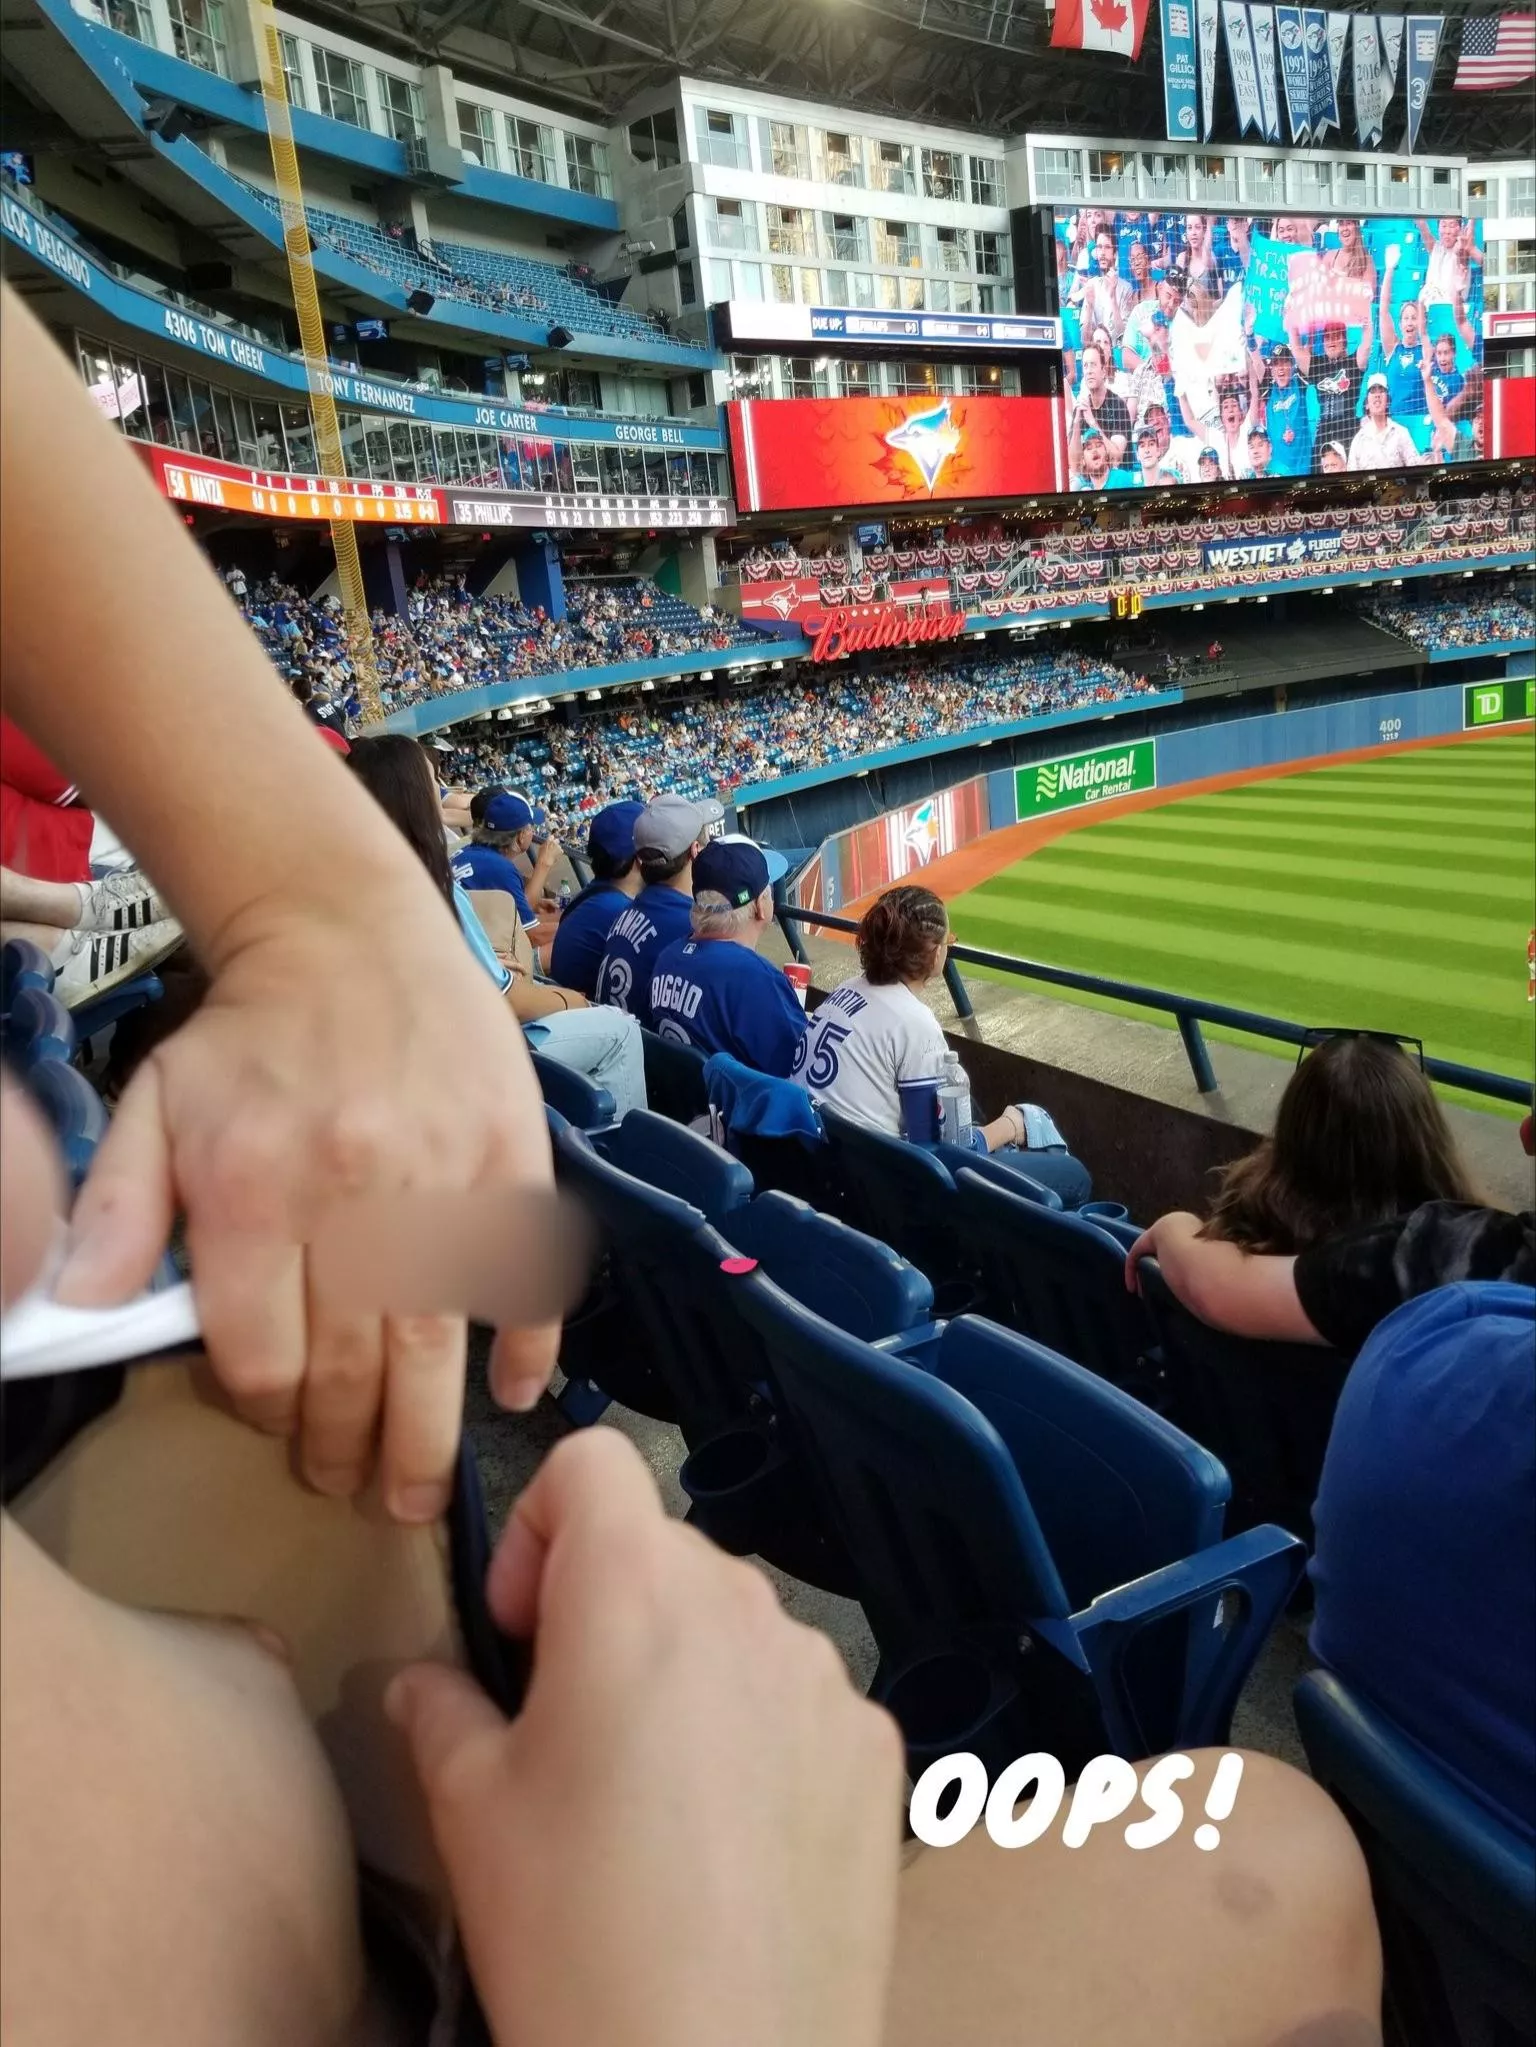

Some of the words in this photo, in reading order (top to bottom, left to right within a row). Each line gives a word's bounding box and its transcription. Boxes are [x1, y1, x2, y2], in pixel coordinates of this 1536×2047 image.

[1176, 53, 1189, 64] PAT
[1260, 53, 1274, 70] 199
[1284, 55, 1306, 73] 1992
[1309, 54, 1329, 79] 1993
[1286, 76, 1307, 87] WORL
[1357, 62, 1380, 81] 2016
[1411, 77, 1427, 110] 3
[34, 222, 90, 289] DELGADO
[812, 316, 829, 331] DUE
[165, 309, 197, 345] 4306
[199, 324, 229, 358] TOM
[231, 338, 266, 374] CHEEK
[317, 372, 349, 398] TONY
[354, 381, 416, 414] FERNANDEZ
[475, 407, 497, 426] JOE
[500, 411, 538, 432] CARTER
[615, 425, 658, 442] GEORGE
[662, 429, 685, 443] BELL
[458, 503, 473, 523] 35
[474, 504, 514, 525] PHILLIPS
[1308, 538, 1342, 551] FLIGHT
[802, 610, 966, 663] Budweiser
[1476, 692, 1500, 716] TD
[1379, 718, 1402, 733] 400
[1085, 787, 1101, 801] Car
[1102, 778, 1132, 797] Rental
[651, 974, 703, 1019] BIGGIO
